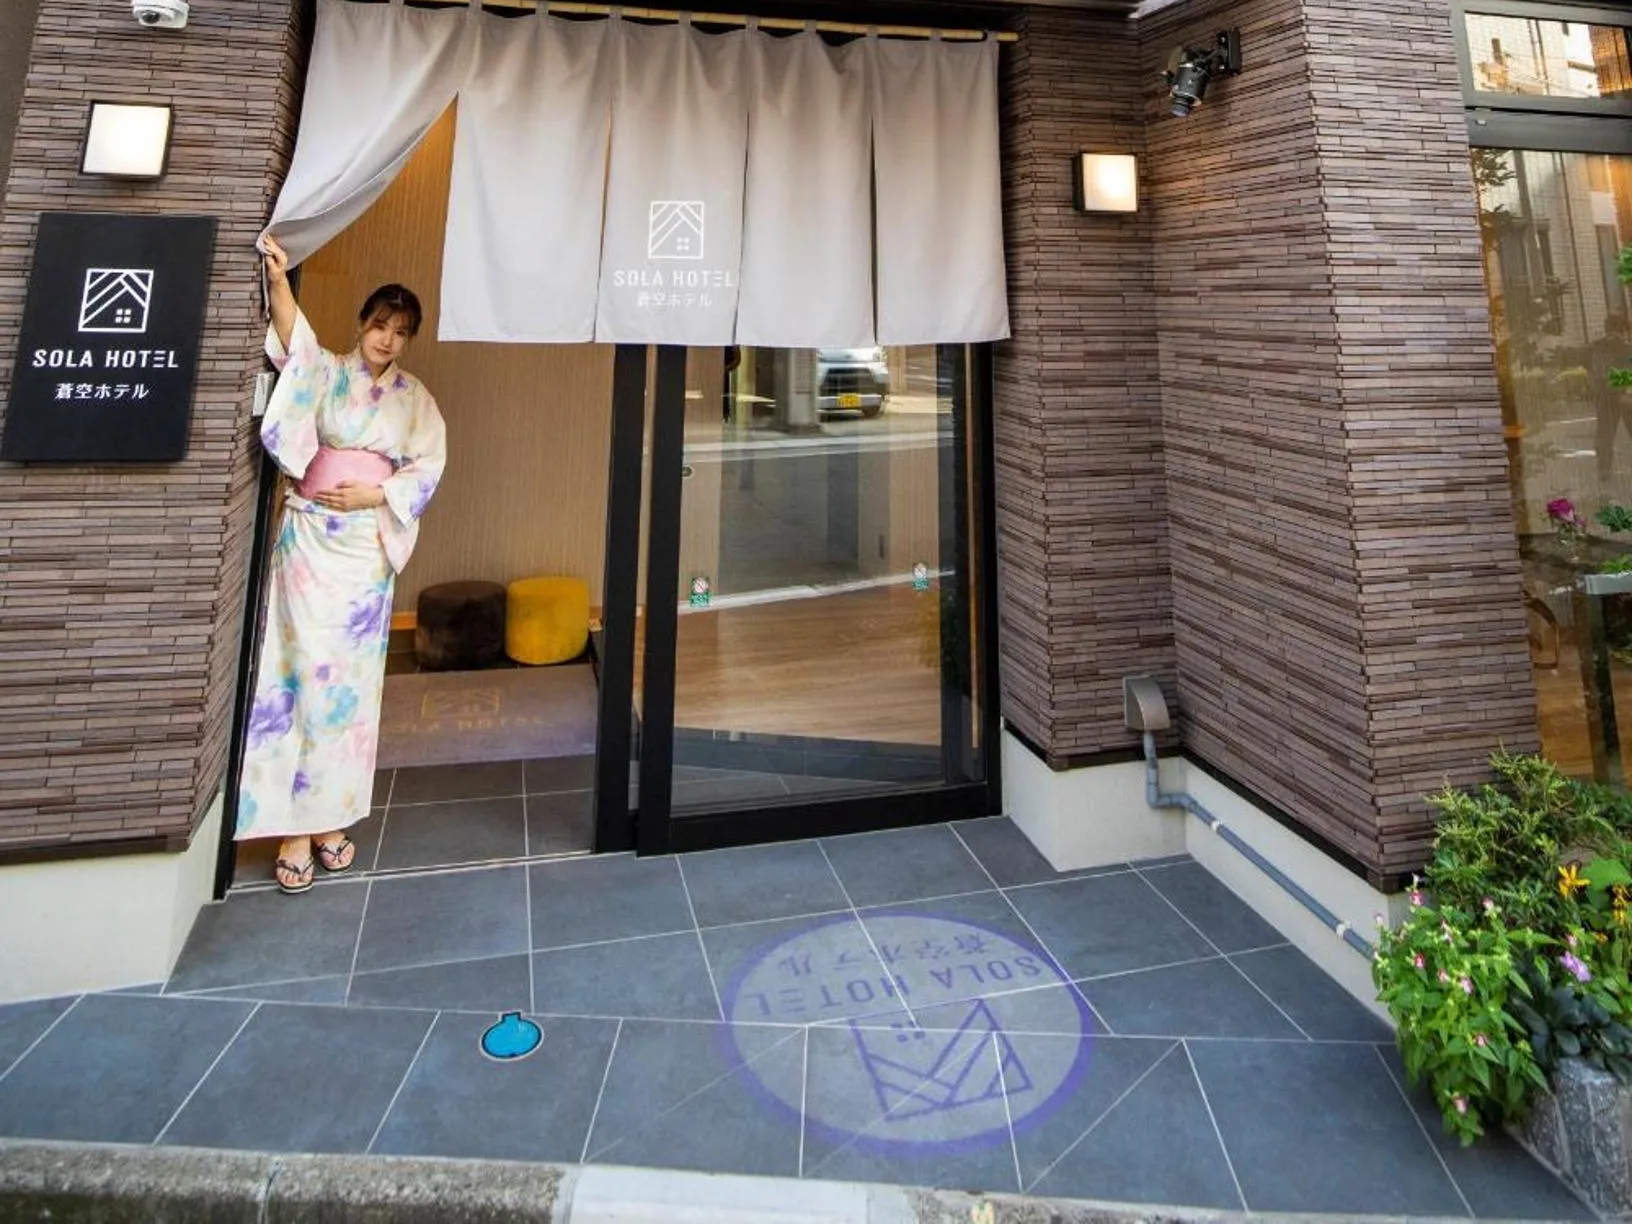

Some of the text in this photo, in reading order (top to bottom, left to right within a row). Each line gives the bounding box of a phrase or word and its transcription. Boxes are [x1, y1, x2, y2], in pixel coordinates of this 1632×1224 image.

[614, 269, 733, 287] SOLA HOTEL
[32, 349, 179, 368] SOLA HOTEL
[55, 383, 150, 400] 蒼空ホテル
[743, 955, 1042, 1016] SOLA HOTEL
